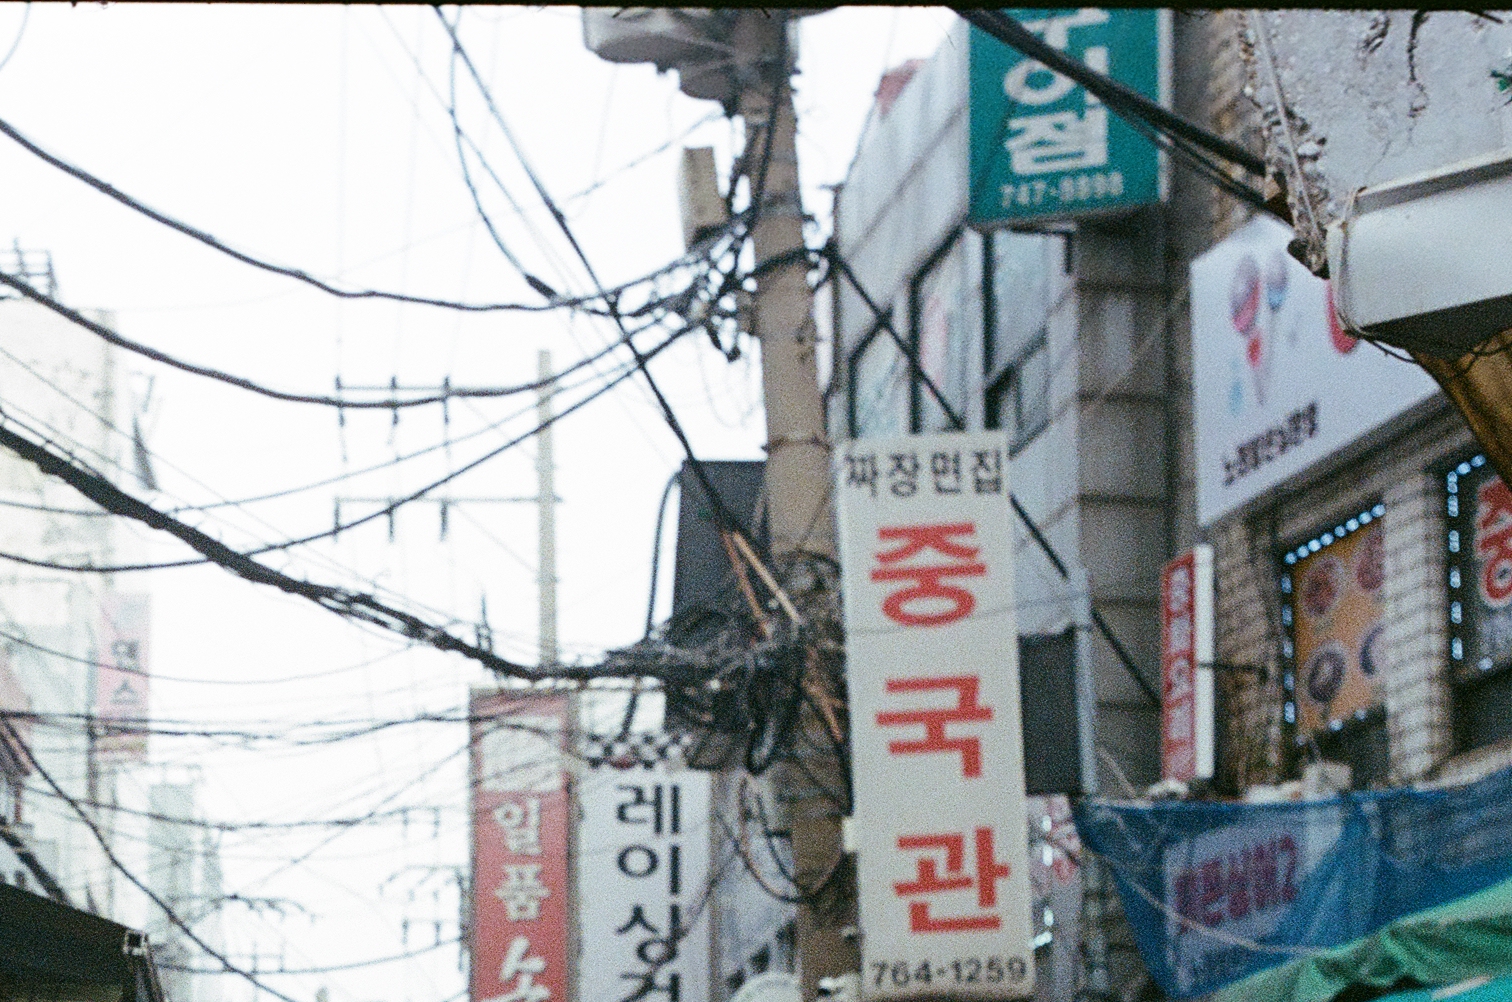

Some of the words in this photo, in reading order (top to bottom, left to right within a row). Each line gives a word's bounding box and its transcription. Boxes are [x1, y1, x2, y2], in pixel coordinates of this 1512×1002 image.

[844, 450, 1003, 498] 짜장면집
[870, 521, 1011, 935] 중국관
[493, 798, 552, 922] 일품
